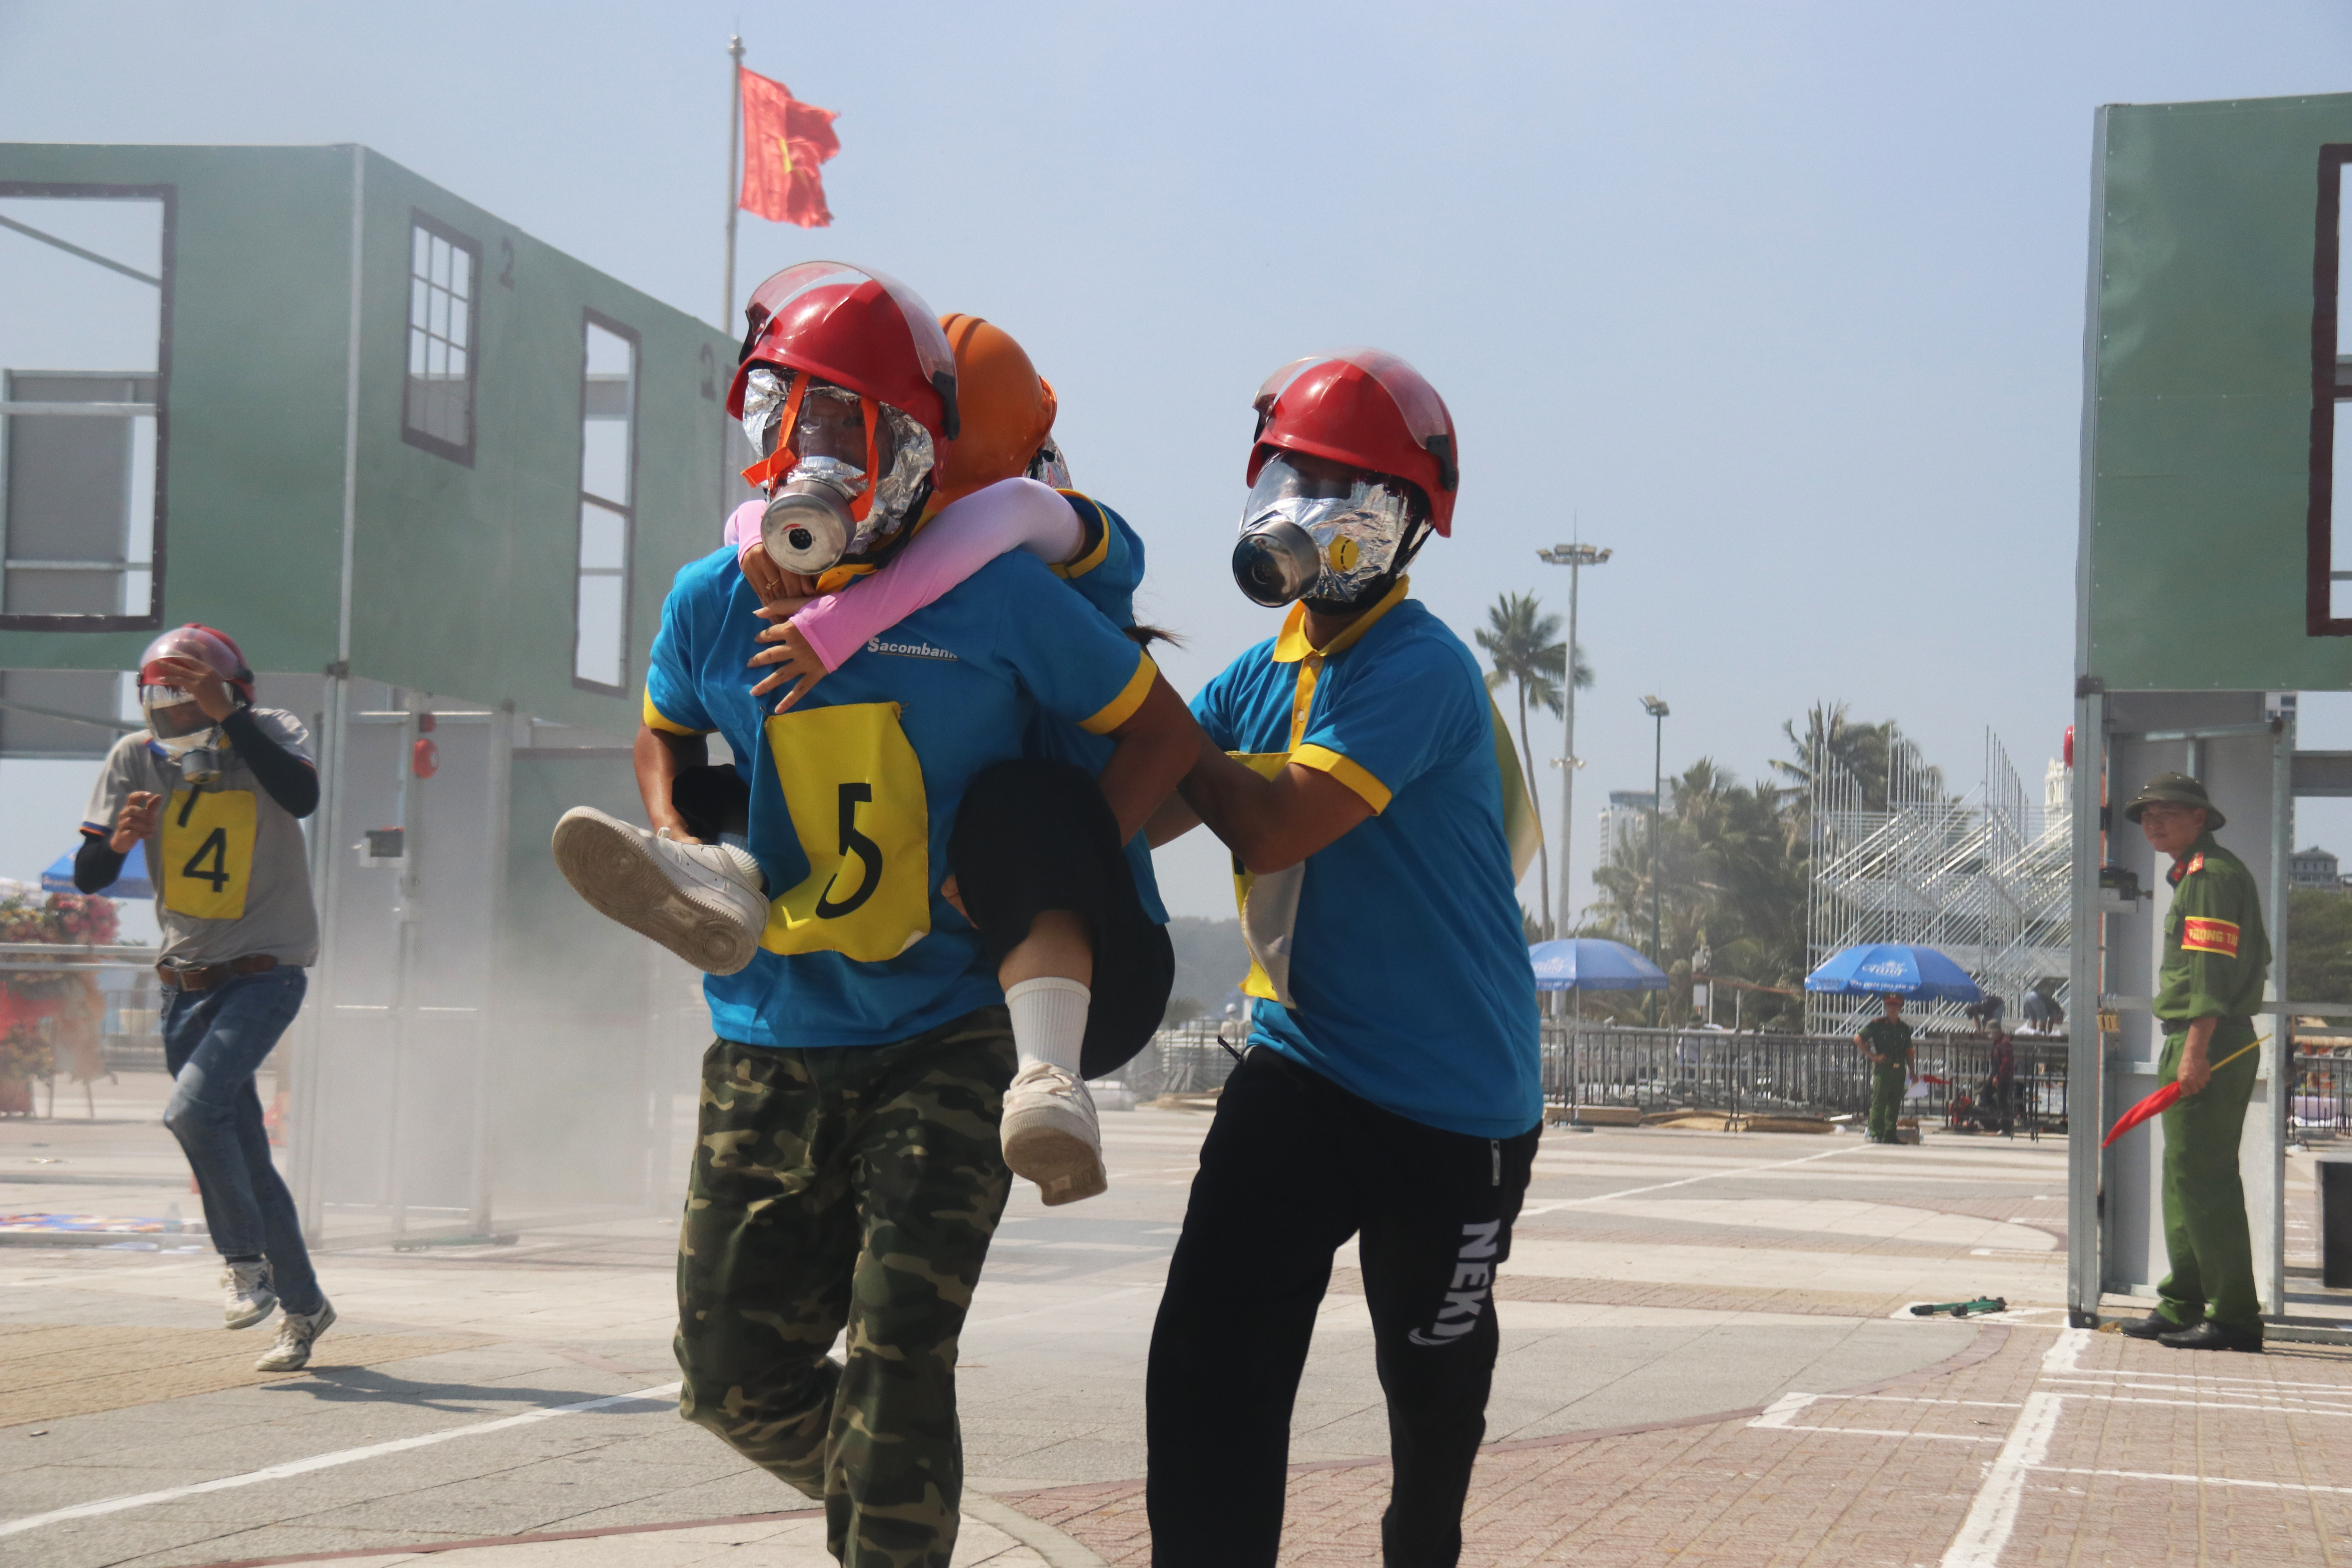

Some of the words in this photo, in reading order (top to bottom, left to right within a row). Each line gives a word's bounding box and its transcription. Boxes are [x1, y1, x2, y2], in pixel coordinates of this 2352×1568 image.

[500, 237, 515, 290] 2
[183, 828, 230, 892] 4
[815, 782, 883, 919] 5
[2189, 929, 2223, 943] TRỌNG
